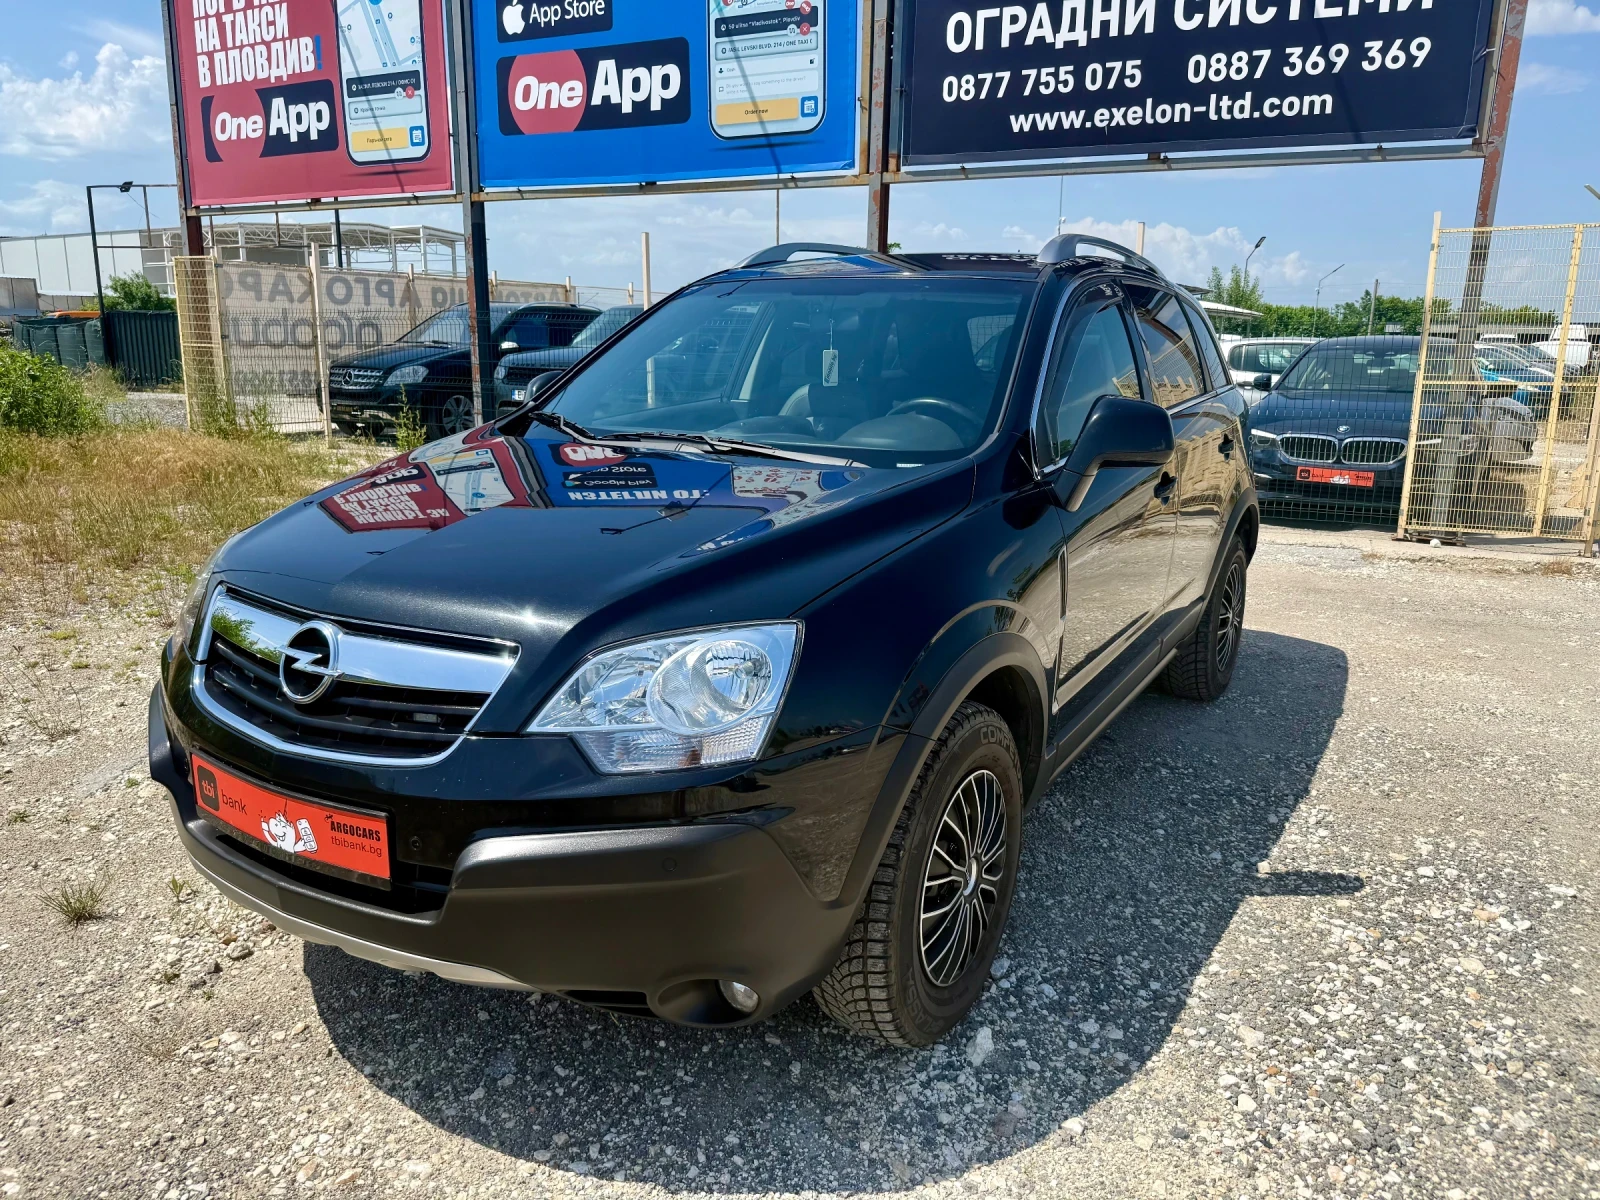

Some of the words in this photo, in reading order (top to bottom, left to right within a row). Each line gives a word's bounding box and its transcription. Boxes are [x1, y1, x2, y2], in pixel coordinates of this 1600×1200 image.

[194, 17, 221, 53] НА
[222, 3, 289, 48] ТАКСИ
[529, 3, 561, 27] App
[565, 0, 605, 19] Store
[946, 0, 1156, 53] ОГРАДНИ
[197, 55, 211, 88] В
[214, 35, 322, 86] ПЛОВДИВ!
[942, 71, 1011, 102] 0877
[1021, 65, 1074, 96] 755
[1085, 59, 1142, 91] 075
[1187, 49, 1272, 83] 0887
[1282, 43, 1350, 77] 369
[1361, 36, 1432, 71] 369
[514, 76, 583, 110] One
[590, 59, 681, 114] App
[214, 111, 263, 142] One
[269, 97, 330, 143] App
[1009, 91, 1333, 133] www.exelon-ltd.com
[201, 779, 215, 799] tbi
[221, 789, 248, 816] bank
[330, 821, 381, 842] ARGOCARS
[330, 835, 383, 857] tbibank.bg
